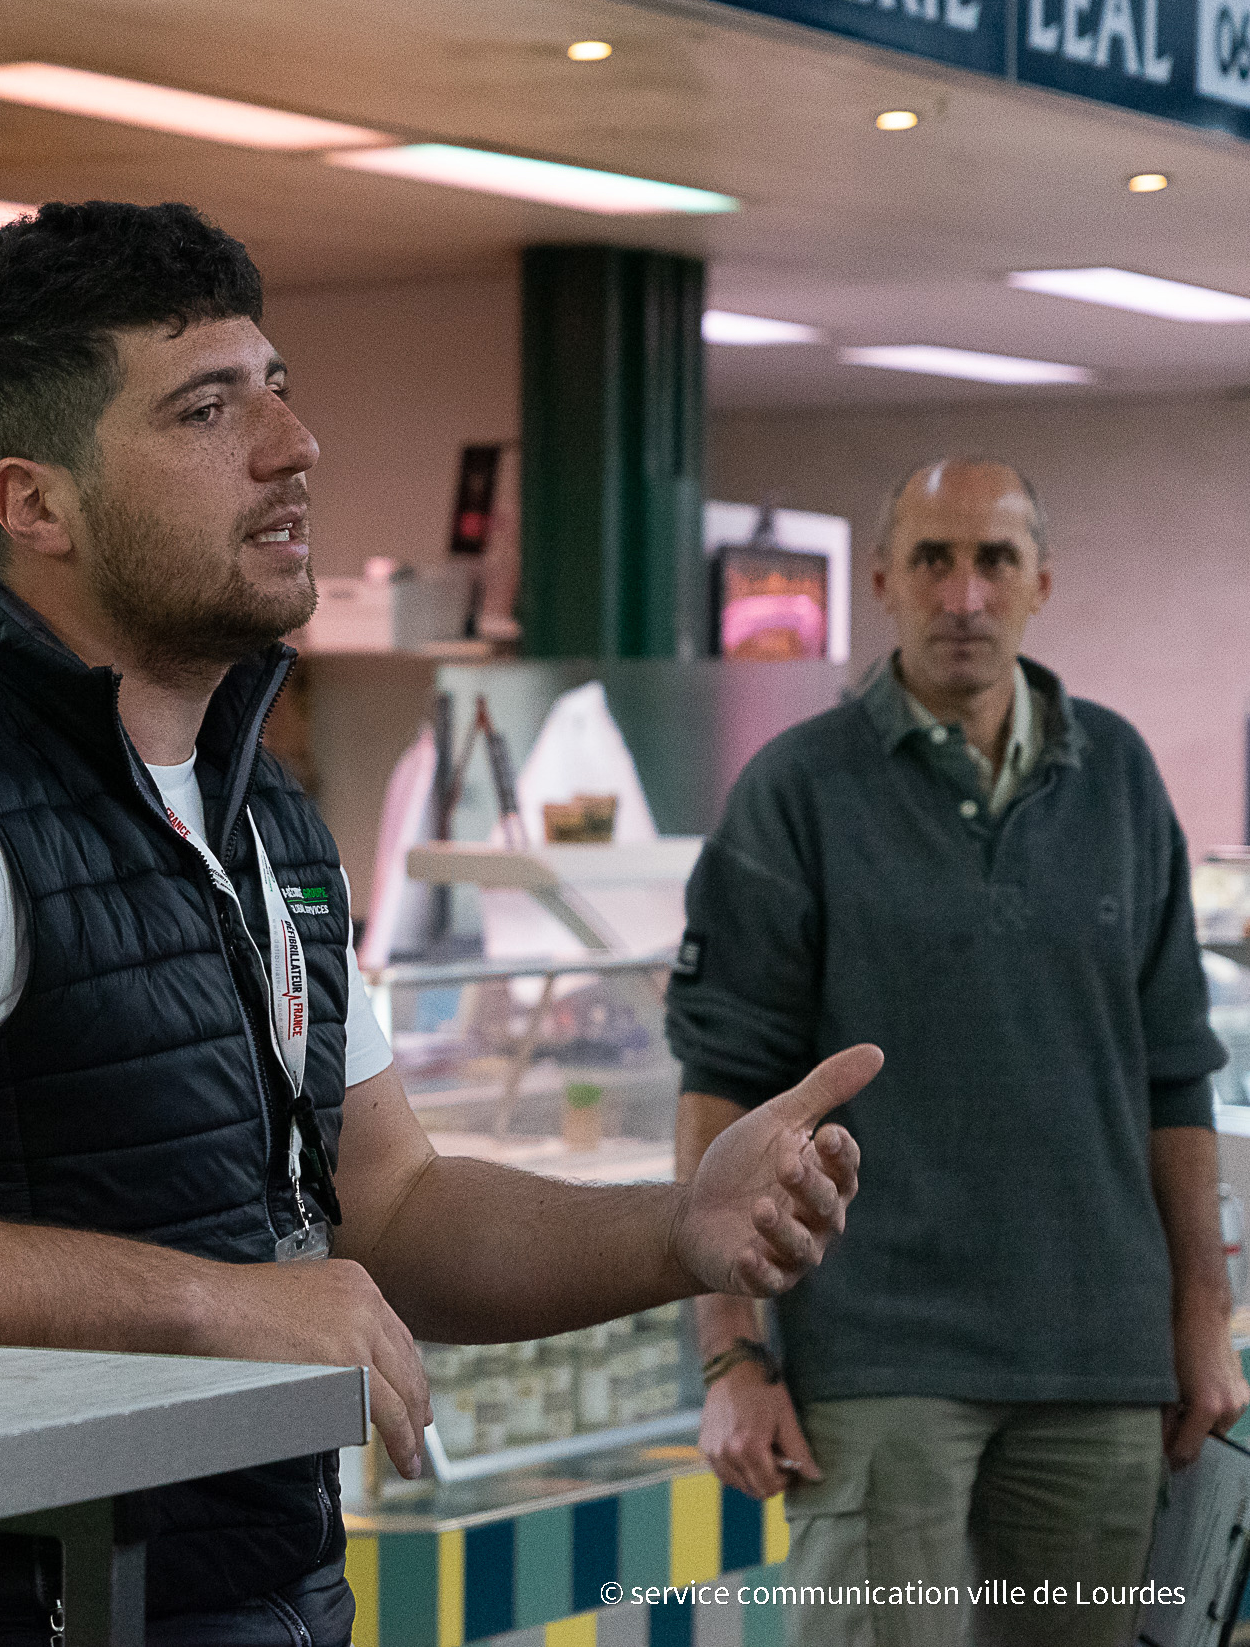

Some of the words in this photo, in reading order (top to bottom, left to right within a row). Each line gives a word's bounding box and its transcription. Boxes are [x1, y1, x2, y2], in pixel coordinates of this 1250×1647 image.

[166, 807, 191, 840] FRANCE
[285, 920, 303, 994] DÉFIBRILLATEUR
[292, 1002, 304, 1038] FRANCE
